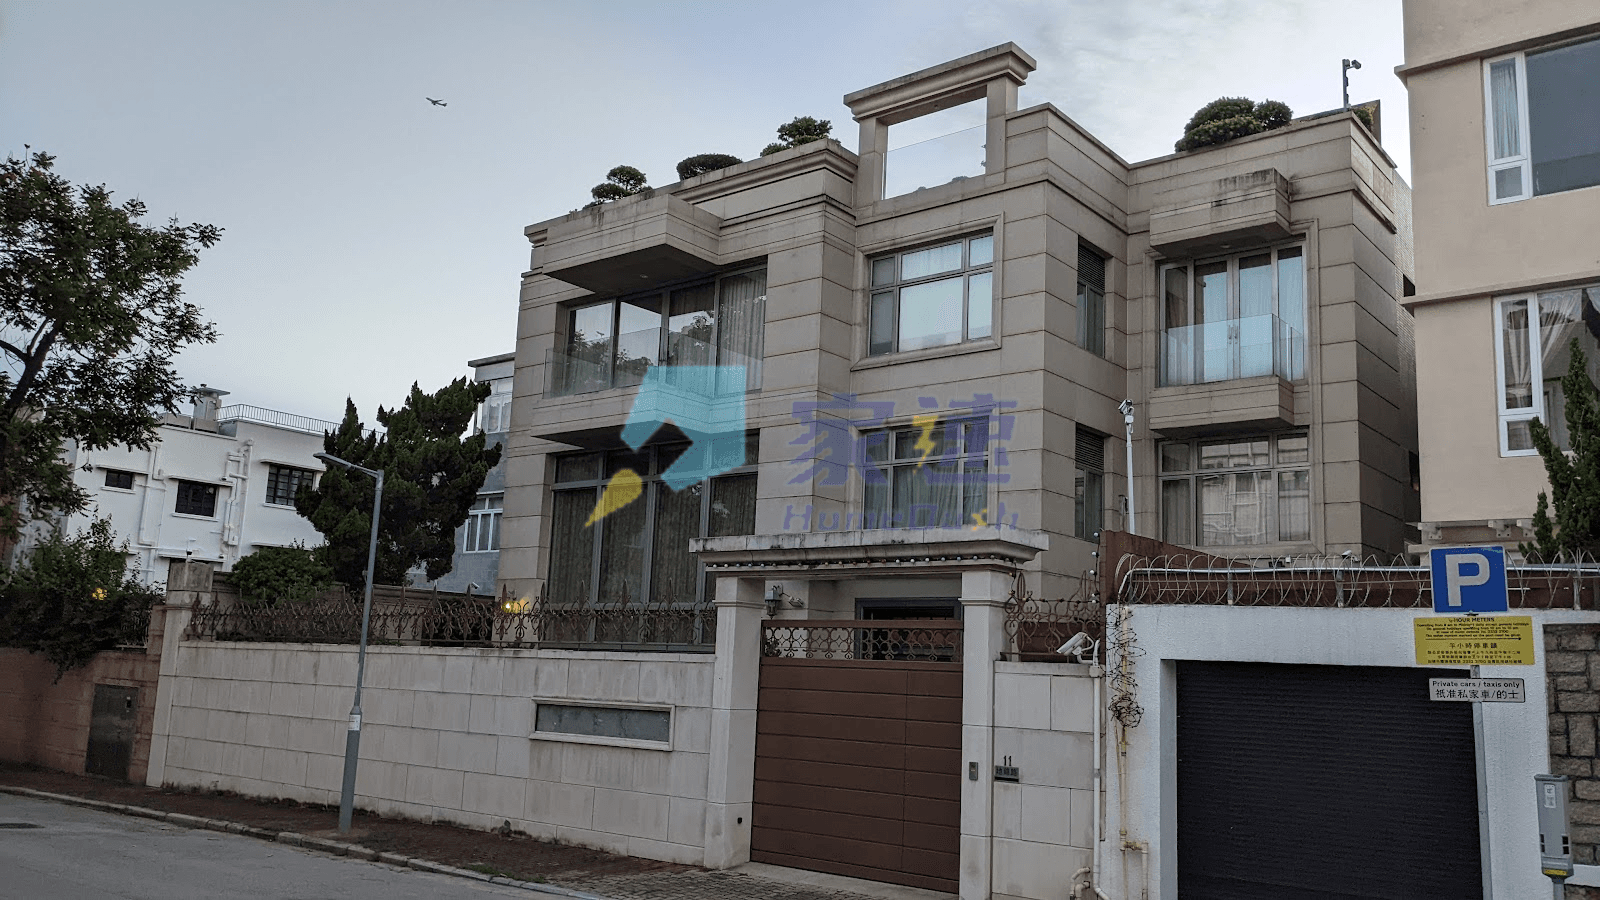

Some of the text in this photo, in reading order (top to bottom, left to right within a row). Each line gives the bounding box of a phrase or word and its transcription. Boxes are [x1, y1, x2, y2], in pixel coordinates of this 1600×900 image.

[1445, 553, 1490, 607] P
[1503, 681, 1520, 689] only
[1003, 755, 1012, 766] 11
